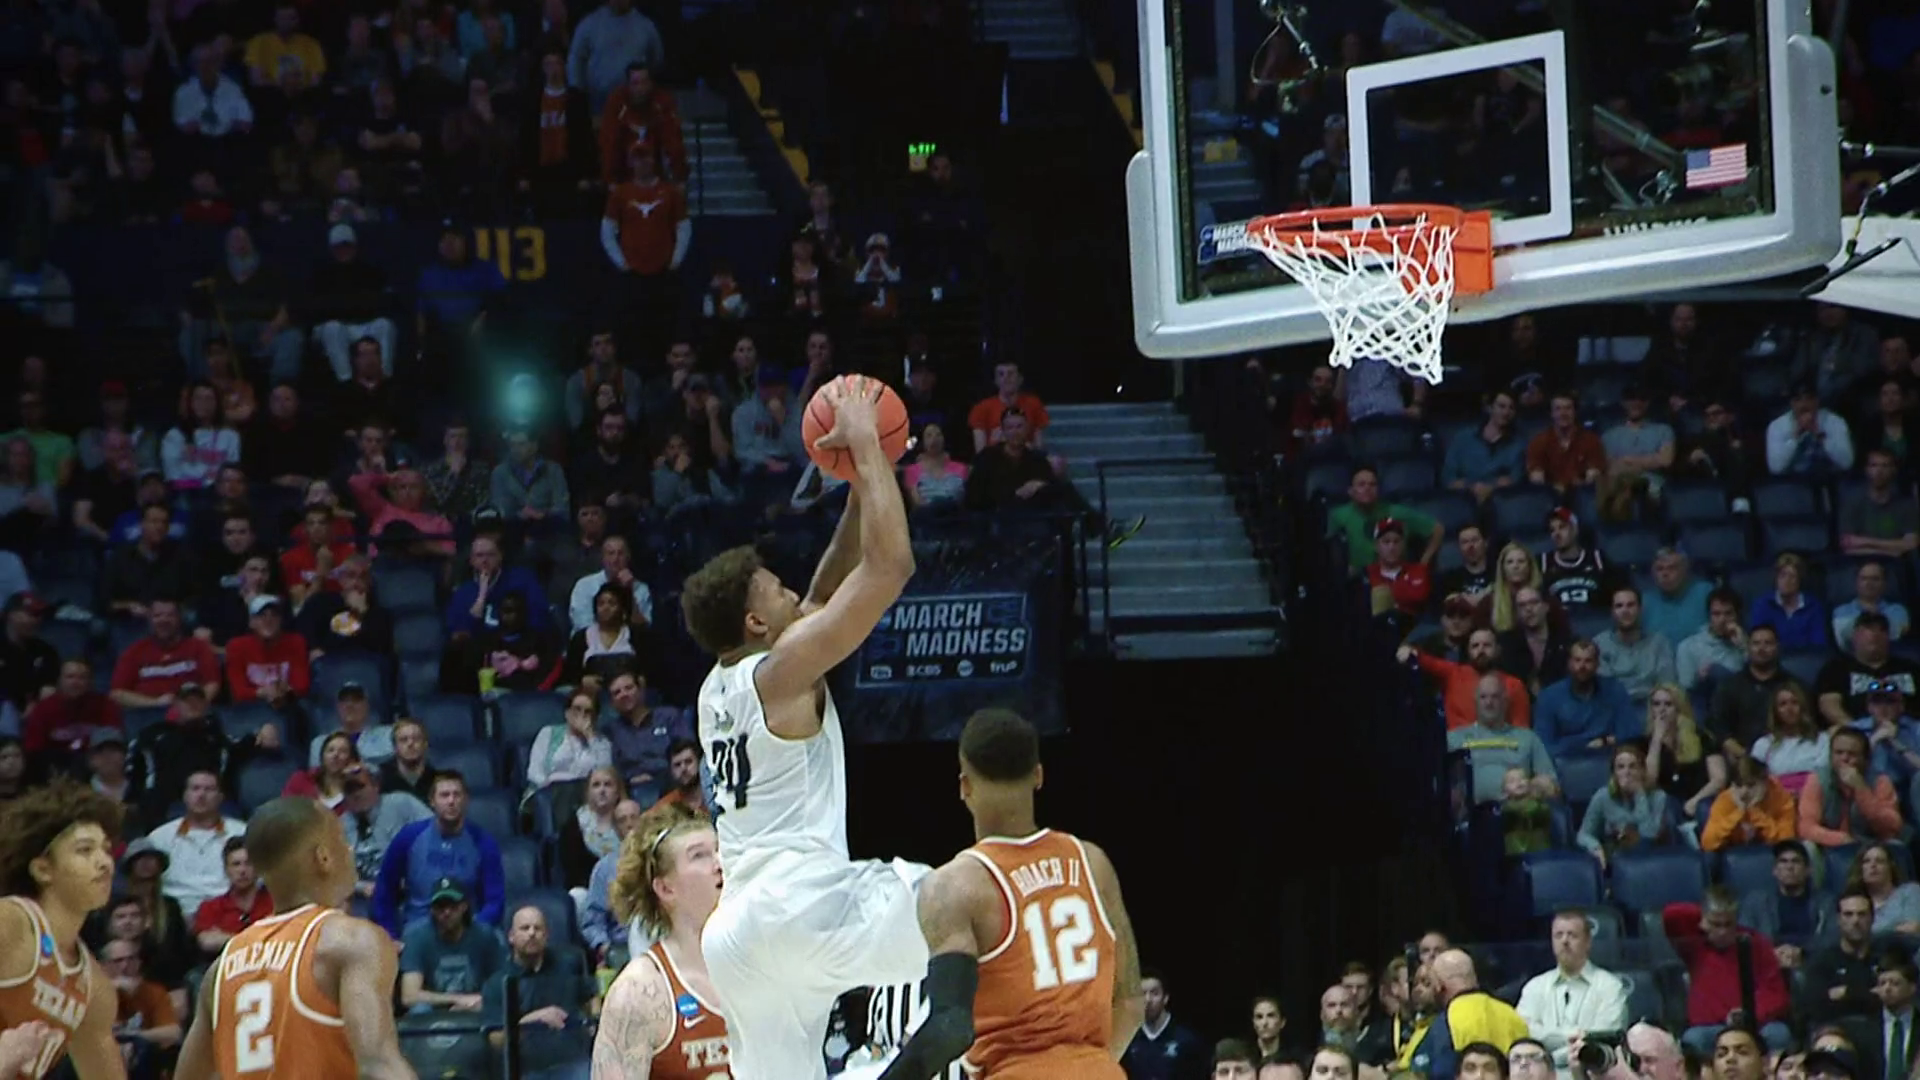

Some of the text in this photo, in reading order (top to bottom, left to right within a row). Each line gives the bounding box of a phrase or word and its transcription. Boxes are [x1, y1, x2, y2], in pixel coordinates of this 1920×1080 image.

[1213, 222, 1246, 241] MARCH
[893, 602, 983, 630] MARCH
[906, 628, 1026, 657] MADNESS
[1010, 857, 1064, 896] ROACH
[225, 940, 295, 979] COLEMAN
[1022, 893, 1099, 991] 12
[235, 980, 274, 1073] 2
